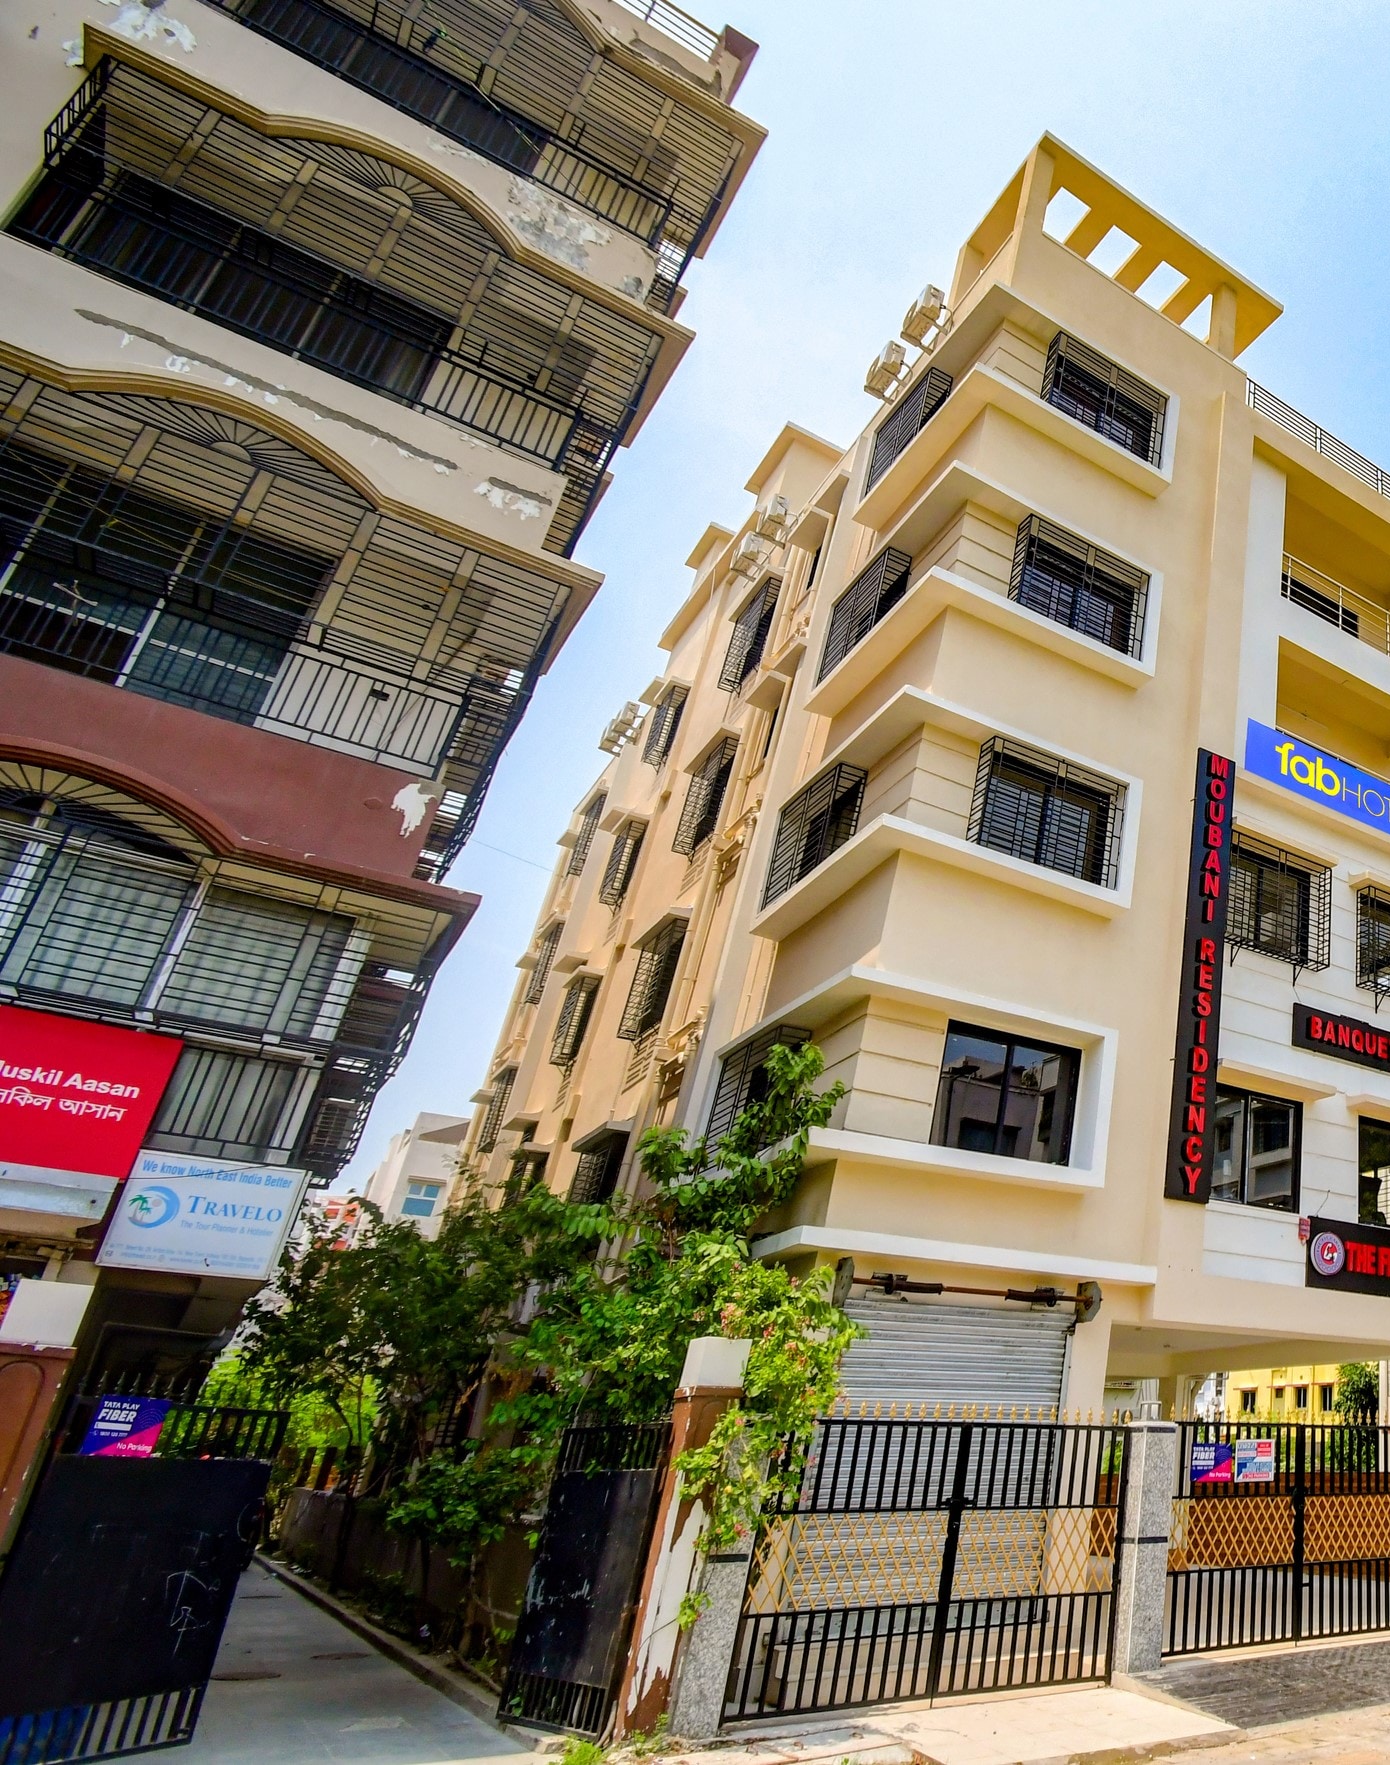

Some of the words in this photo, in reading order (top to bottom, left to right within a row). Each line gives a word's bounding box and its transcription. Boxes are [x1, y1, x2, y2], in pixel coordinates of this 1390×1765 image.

[1203, 754, 1229, 922] MOUBANI
[1184, 937, 1216, 1195] RESIDENCY
[62, 1073, 140, 1099] Aasan
[58, 1097, 128, 1121] আসান
[142, 1159, 158, 1172] We
[160, 1161, 187, 1176] know
[188, 1165, 214, 1180] North
[216, 1169, 237, 1182] East
[239, 1171, 263, 1185] India
[264, 1175, 293, 1189] Better
[180, 1220, 193, 1229] The
[194, 1221, 211, 1231] Tour
[1344, 1240, 1377, 1275] THE
[98, 1408, 138, 1422] FIBER
[104, 1401, 121, 1409] TATA
[122, 1402, 141, 1411] PLAY
[116, 1442, 127, 1450] No
[127, 1443, 153, 1454] Parking
[1192, 1451, 1216, 1460] FIBER
